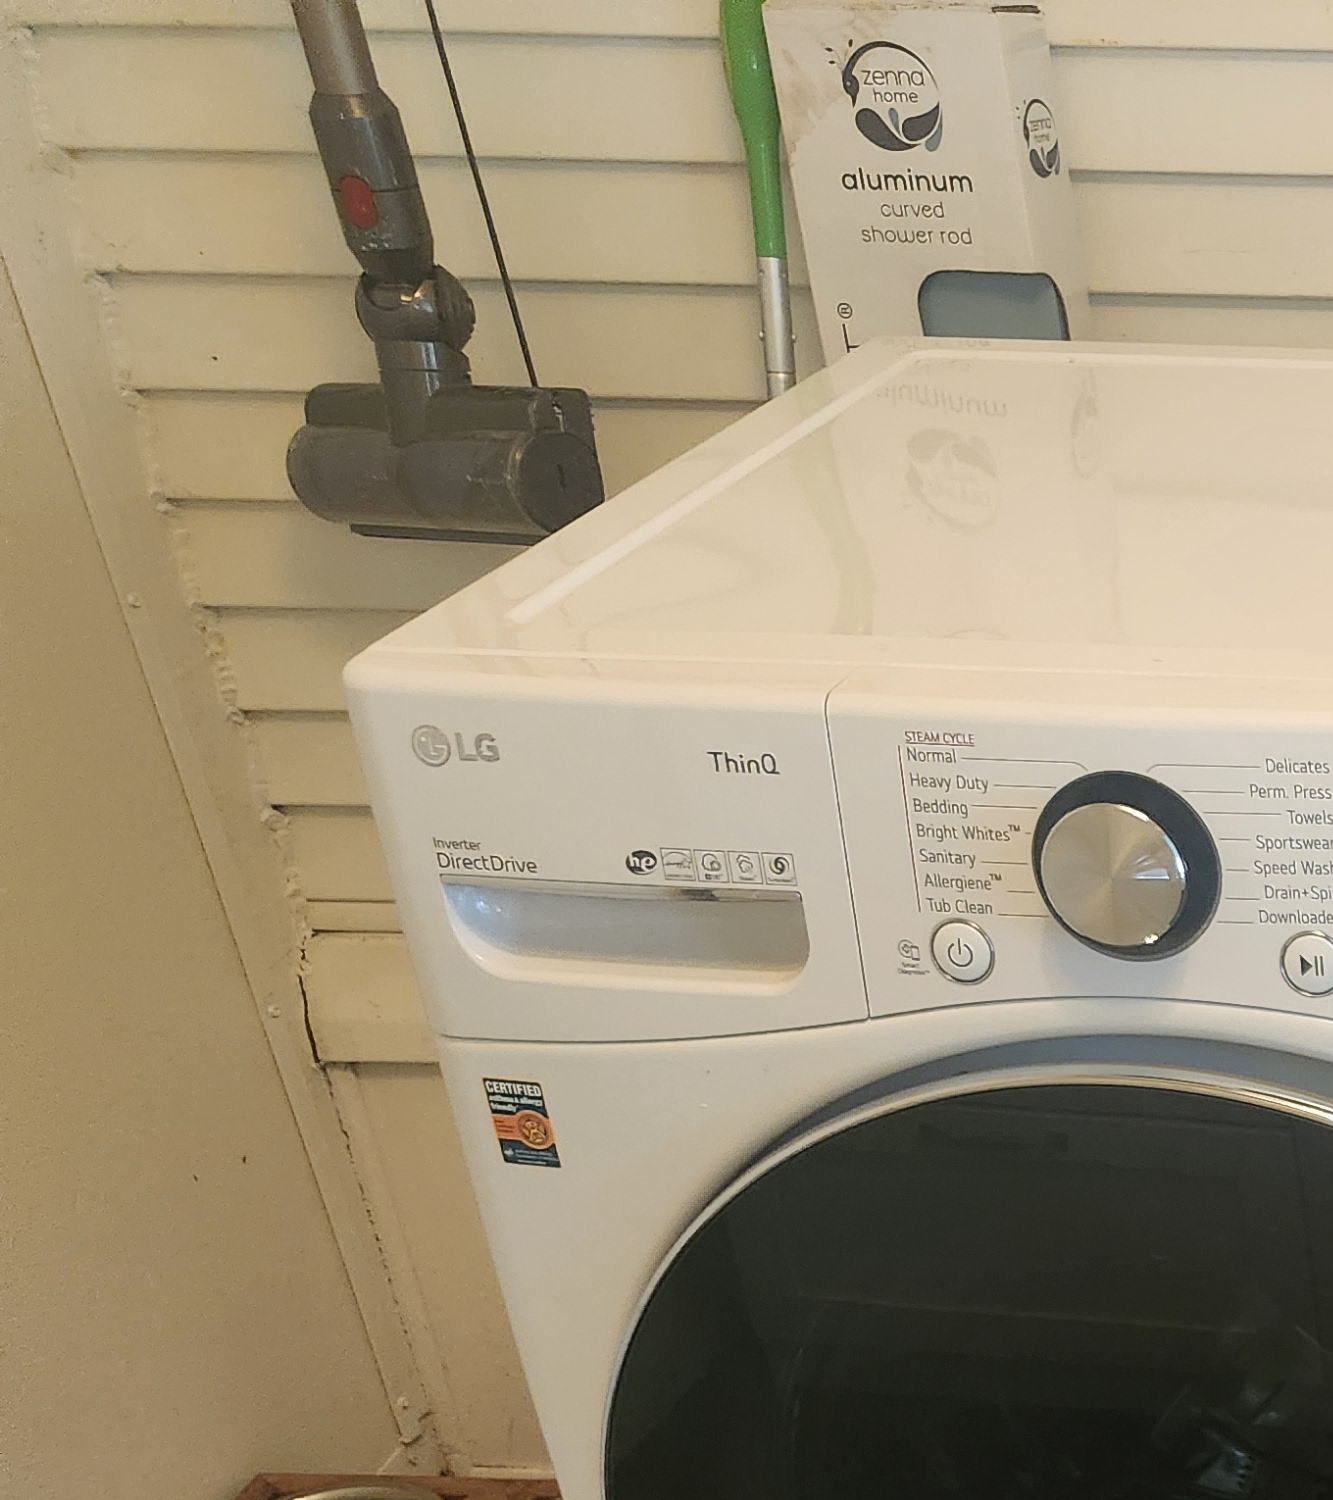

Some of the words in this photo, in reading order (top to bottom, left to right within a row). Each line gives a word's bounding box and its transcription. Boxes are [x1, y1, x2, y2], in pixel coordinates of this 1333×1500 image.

[861, 69, 926, 86] zenna
[873, 88, 919, 103] home
[841, 167, 974, 193] aluminum
[880, 201, 945, 219] curved
[861, 225, 933, 243] shower
[940, 228, 973, 244] rod
[455, 732, 500, 762] LG
[905, 731, 940, 743] STEAM
[943, 732, 975, 745] CYCLE
[707, 751, 780, 775] ThinQ
[906, 747, 957, 763] Normal
[1265, 758, 1330, 774] Delicates
[910, 772, 951, 793] Heavy
[956, 775, 989, 794] Duty
[1249, 784, 1289, 799] Perm.
[1293, 785, 1332, 800] Press
[912, 798, 969, 819] Bedding
[1286, 810, 1333, 825] Towels
[916, 823, 958, 842] Bright
[433, 836, 481, 851] Inverter
[436, 852, 538, 874] DirectDrive
[919, 848, 976, 869] Sanitary
[1253, 860, 1297, 878] Speed
[925, 897, 951, 913] Tub
[955, 899, 993, 914] Clean
[485, 1080, 542, 1097] CERTIFIED
